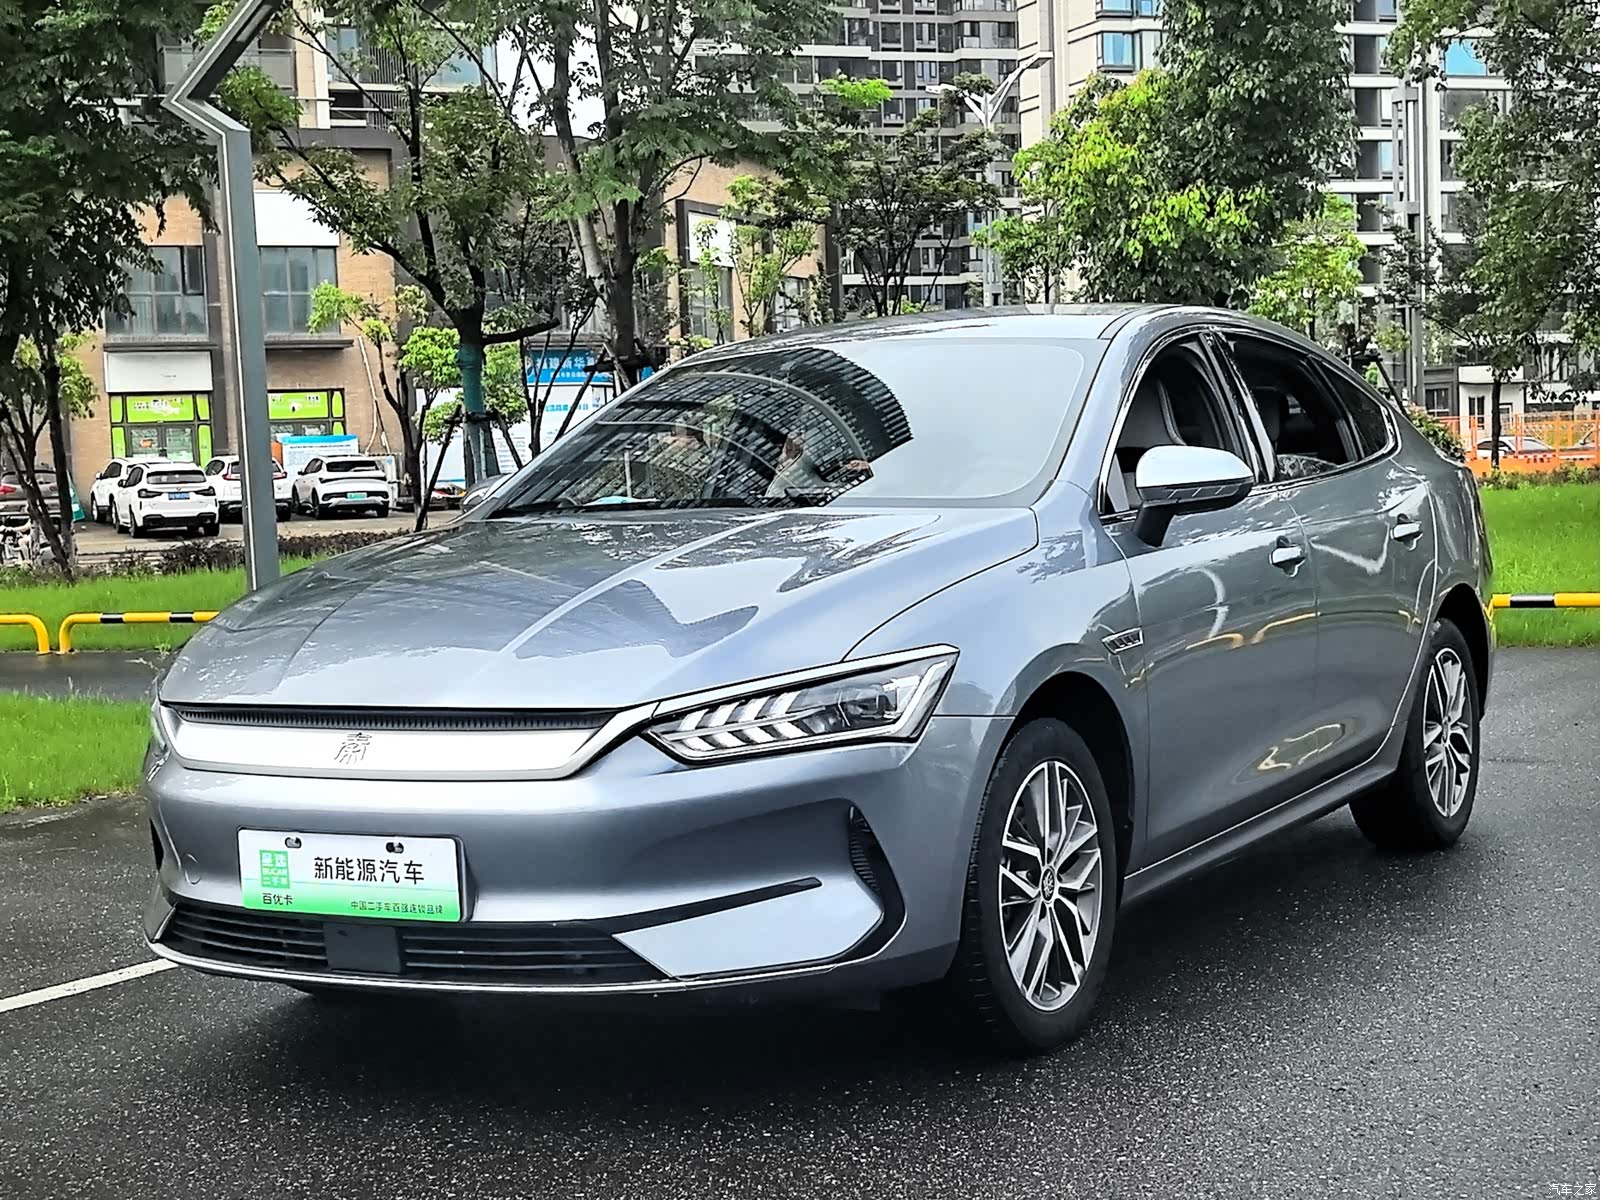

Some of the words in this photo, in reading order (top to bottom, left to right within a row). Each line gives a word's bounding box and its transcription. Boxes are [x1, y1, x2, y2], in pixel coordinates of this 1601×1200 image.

[314, 857, 425, 885] 新能源汽车
[262, 893, 293, 905] 百优卡
